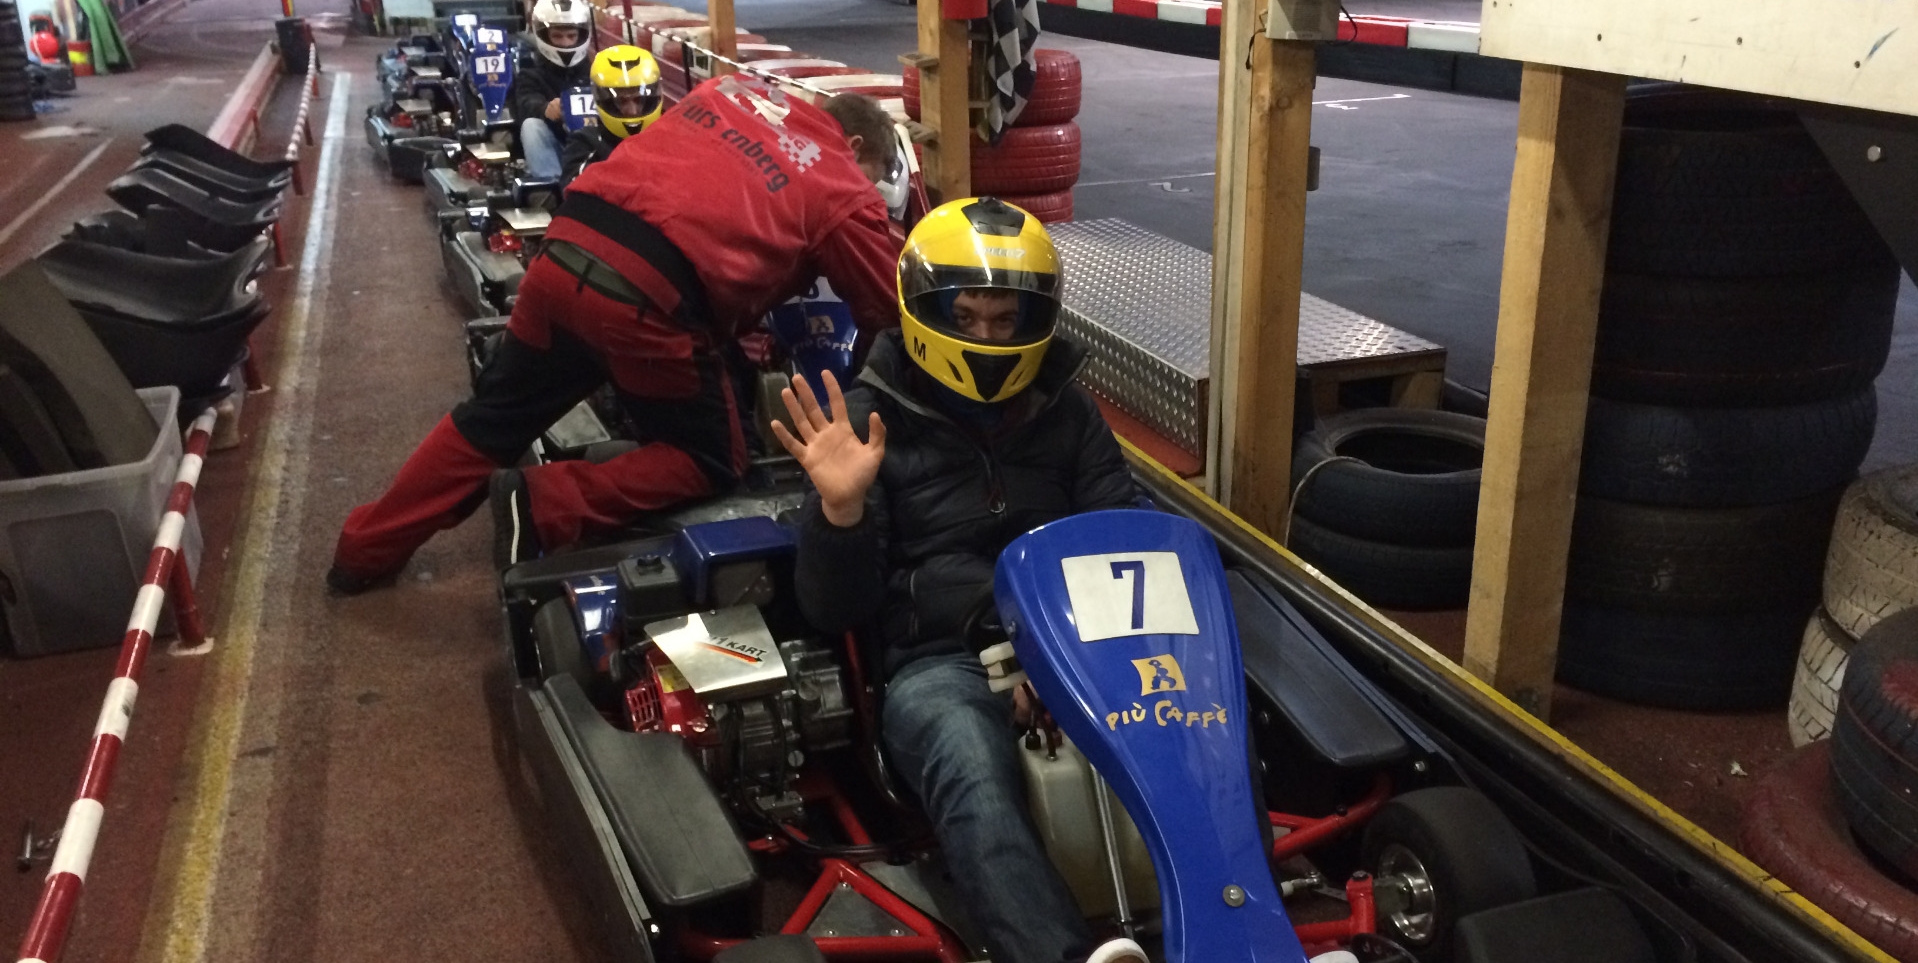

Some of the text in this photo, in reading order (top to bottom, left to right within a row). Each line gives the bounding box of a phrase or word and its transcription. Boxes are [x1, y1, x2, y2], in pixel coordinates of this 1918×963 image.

[483, 58, 500, 73] 19
[913, 335, 927, 362] M
[1109, 560, 1146, 630] 7
[725, 641, 768, 657] KART
